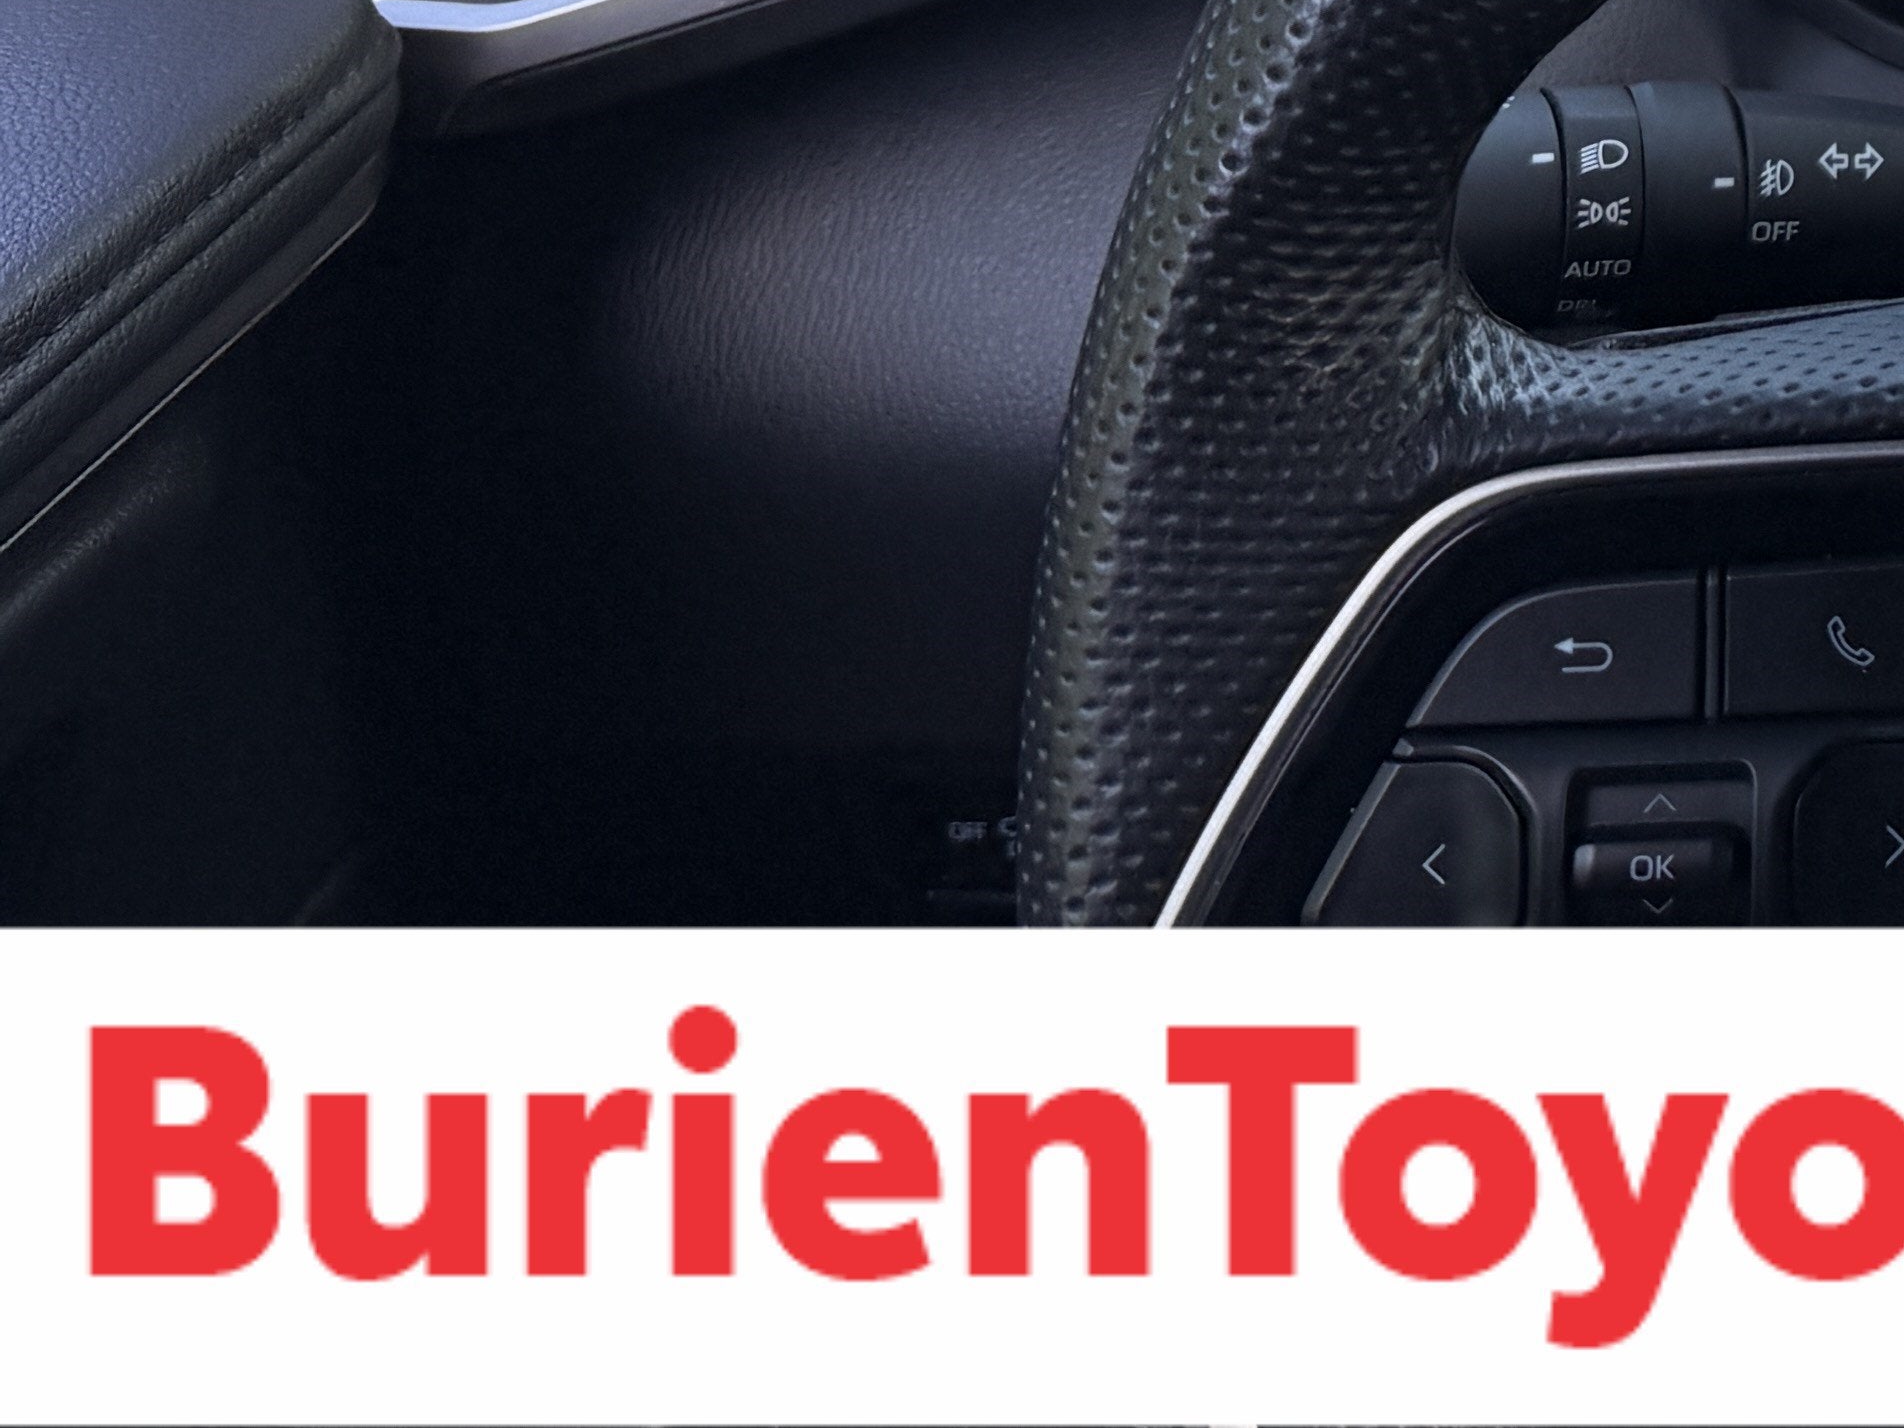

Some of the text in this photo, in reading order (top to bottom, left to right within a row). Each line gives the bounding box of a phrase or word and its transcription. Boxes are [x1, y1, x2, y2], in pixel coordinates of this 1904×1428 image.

[1751, 220, 1800, 243] OFF
[1564, 258, 1632, 279] AUTO
[1629, 853, 1676, 881] OK
